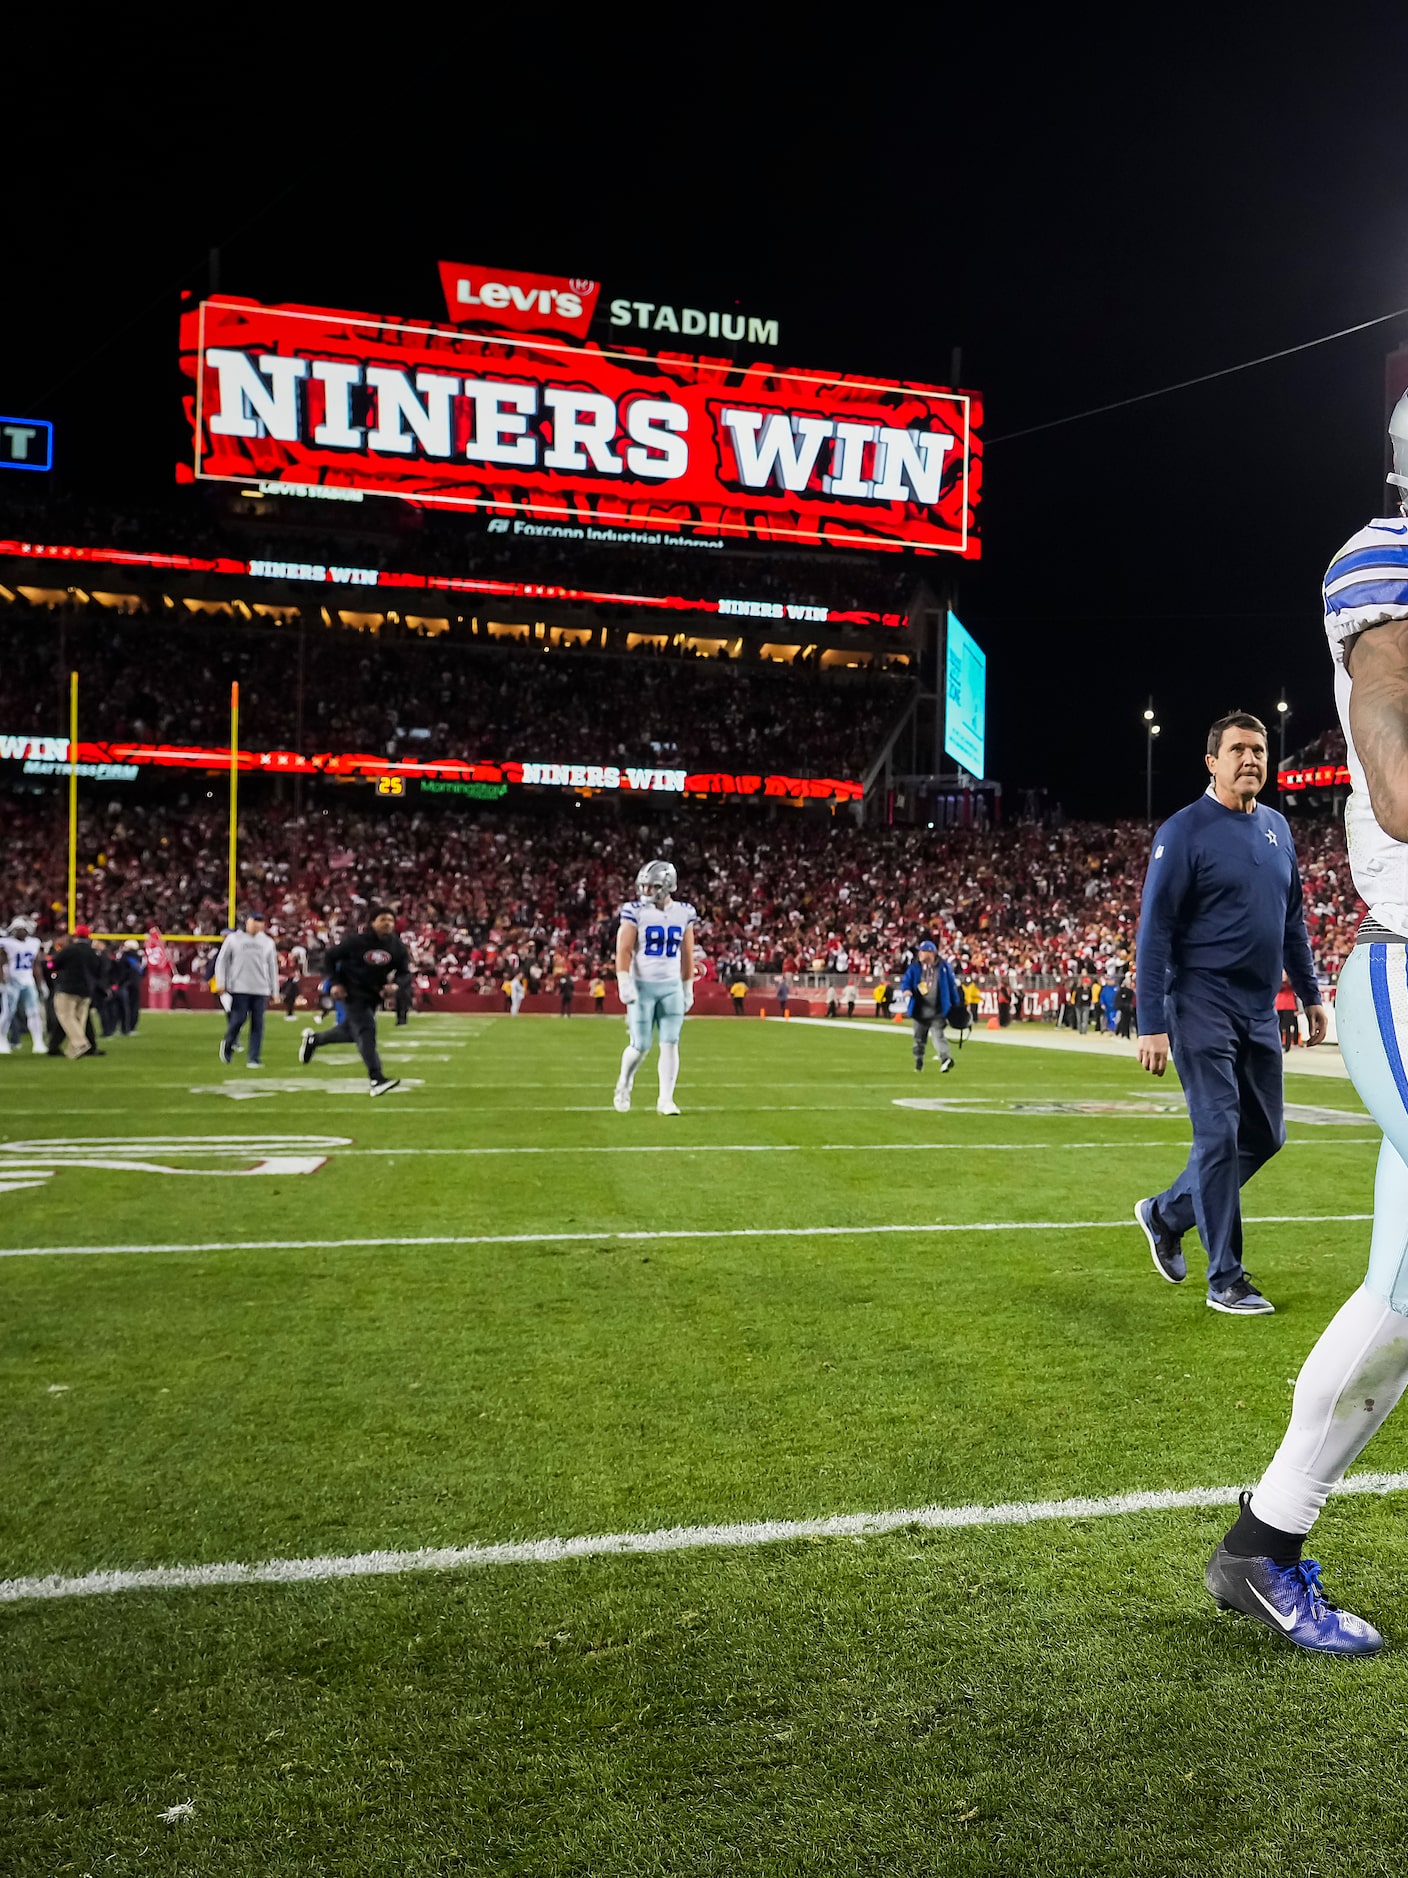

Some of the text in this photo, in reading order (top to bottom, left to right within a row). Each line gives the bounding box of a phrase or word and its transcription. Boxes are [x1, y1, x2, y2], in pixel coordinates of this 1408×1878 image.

[610, 299, 779, 346] STADIUM
[205, 348, 955, 505] NINERS WIN
[513, 520, 585, 539] Foxconn
[586, 527, 662, 545] Industrial
[249, 560, 379, 586] NINERS WIN
[718, 599, 829, 622] NINERS WIN
[0, 734, 70, 762] WIN
[378, 776, 403, 794] 25
[521, 763, 687, 792] NINERS WIN
[644, 925, 682, 957] 86
[15, 952, 33, 971] 13
